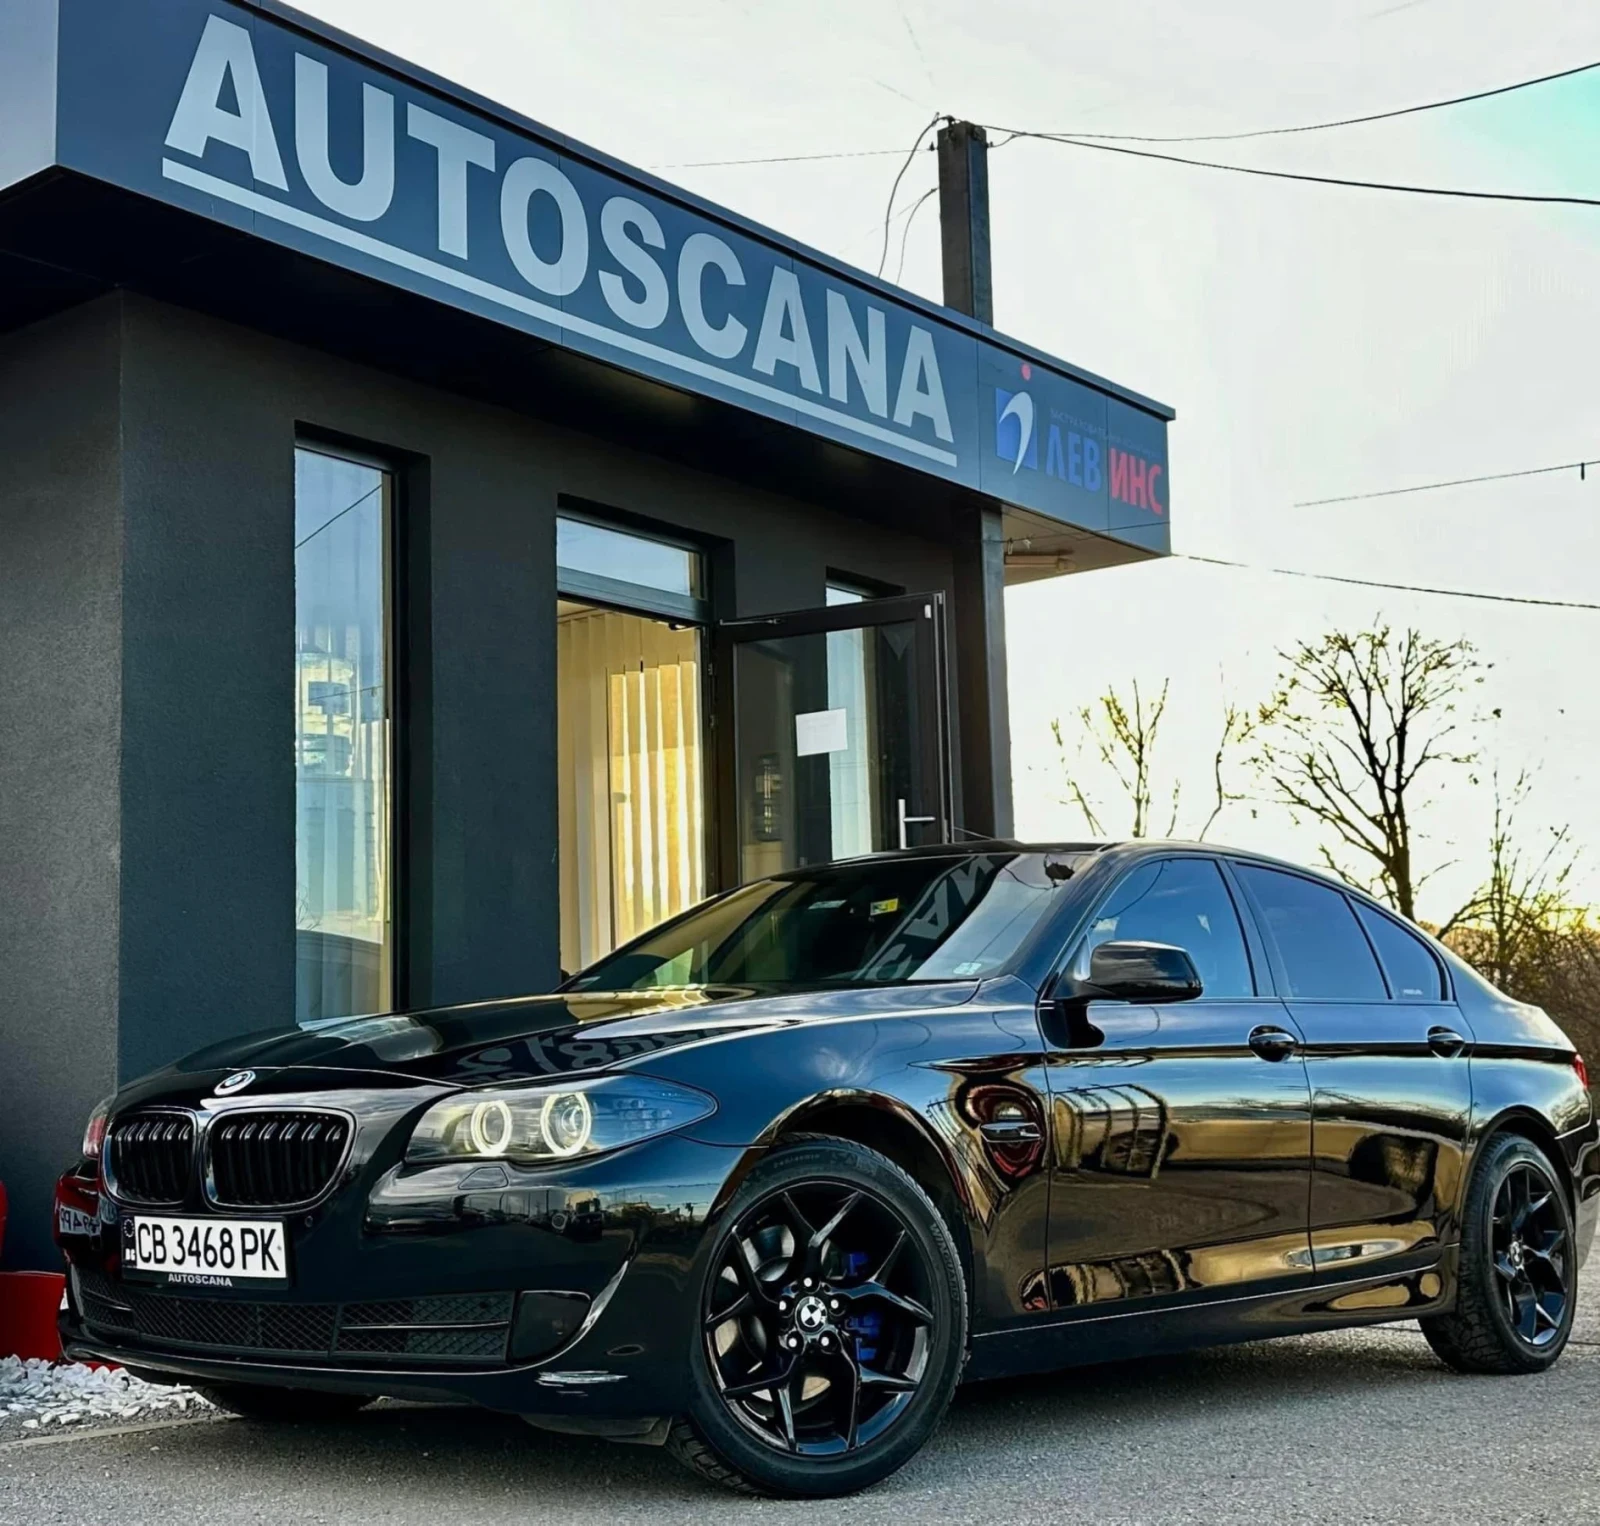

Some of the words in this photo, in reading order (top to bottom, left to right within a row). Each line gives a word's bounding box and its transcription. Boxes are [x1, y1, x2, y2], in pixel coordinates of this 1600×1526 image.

[164, 13, 954, 443] AUTOSCANA
[1045, 424, 1102, 492] ЛЕВ
[1110, 446, 1163, 516] ИНС
[138, 1223, 167, 1264] CB
[172, 1225, 235, 1269] 3468
[240, 1227, 280, 1272] PK
[168, 1273, 233, 1287] AUTOSCANA
